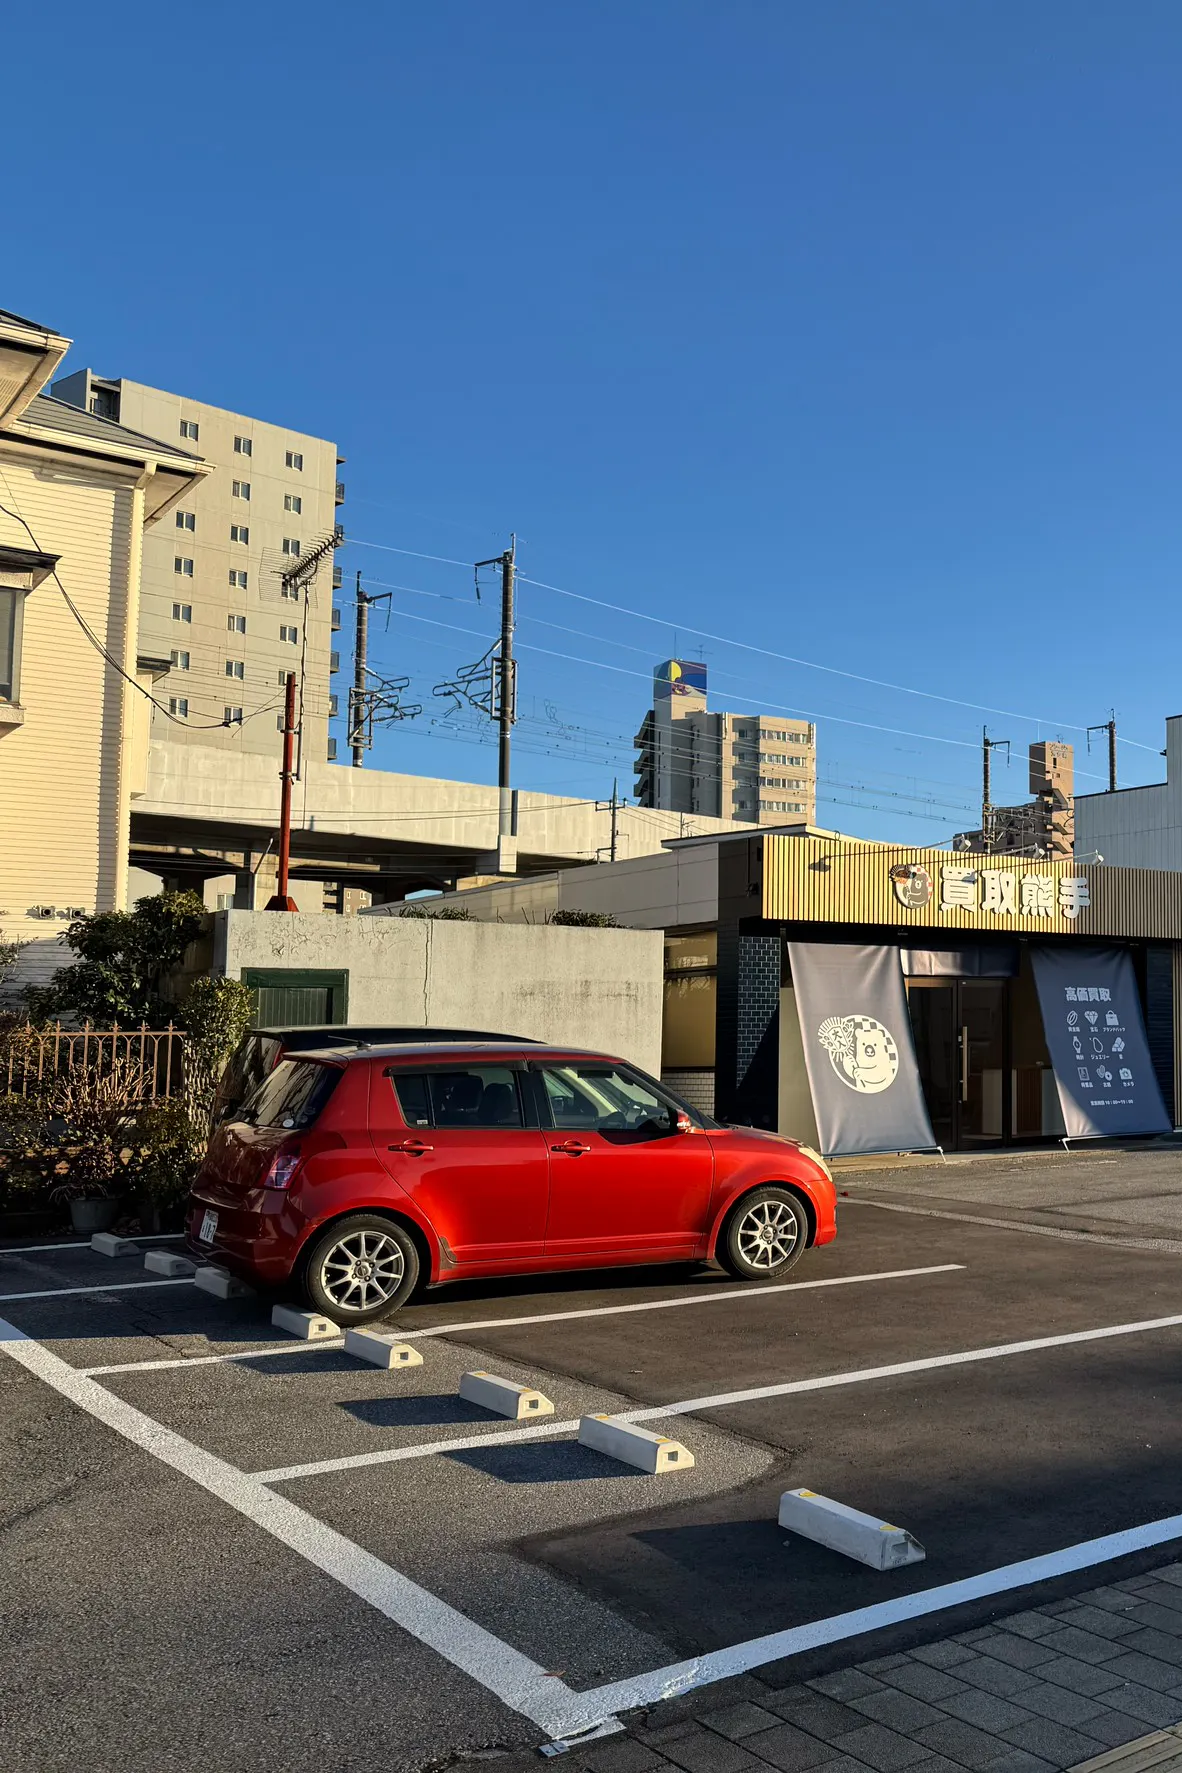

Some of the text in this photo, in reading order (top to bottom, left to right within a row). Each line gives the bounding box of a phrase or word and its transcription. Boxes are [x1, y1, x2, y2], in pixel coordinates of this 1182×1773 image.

[940, 866, 1091, 919] 買取熊手
[1064, 986, 1112, 1002] 高価買取
